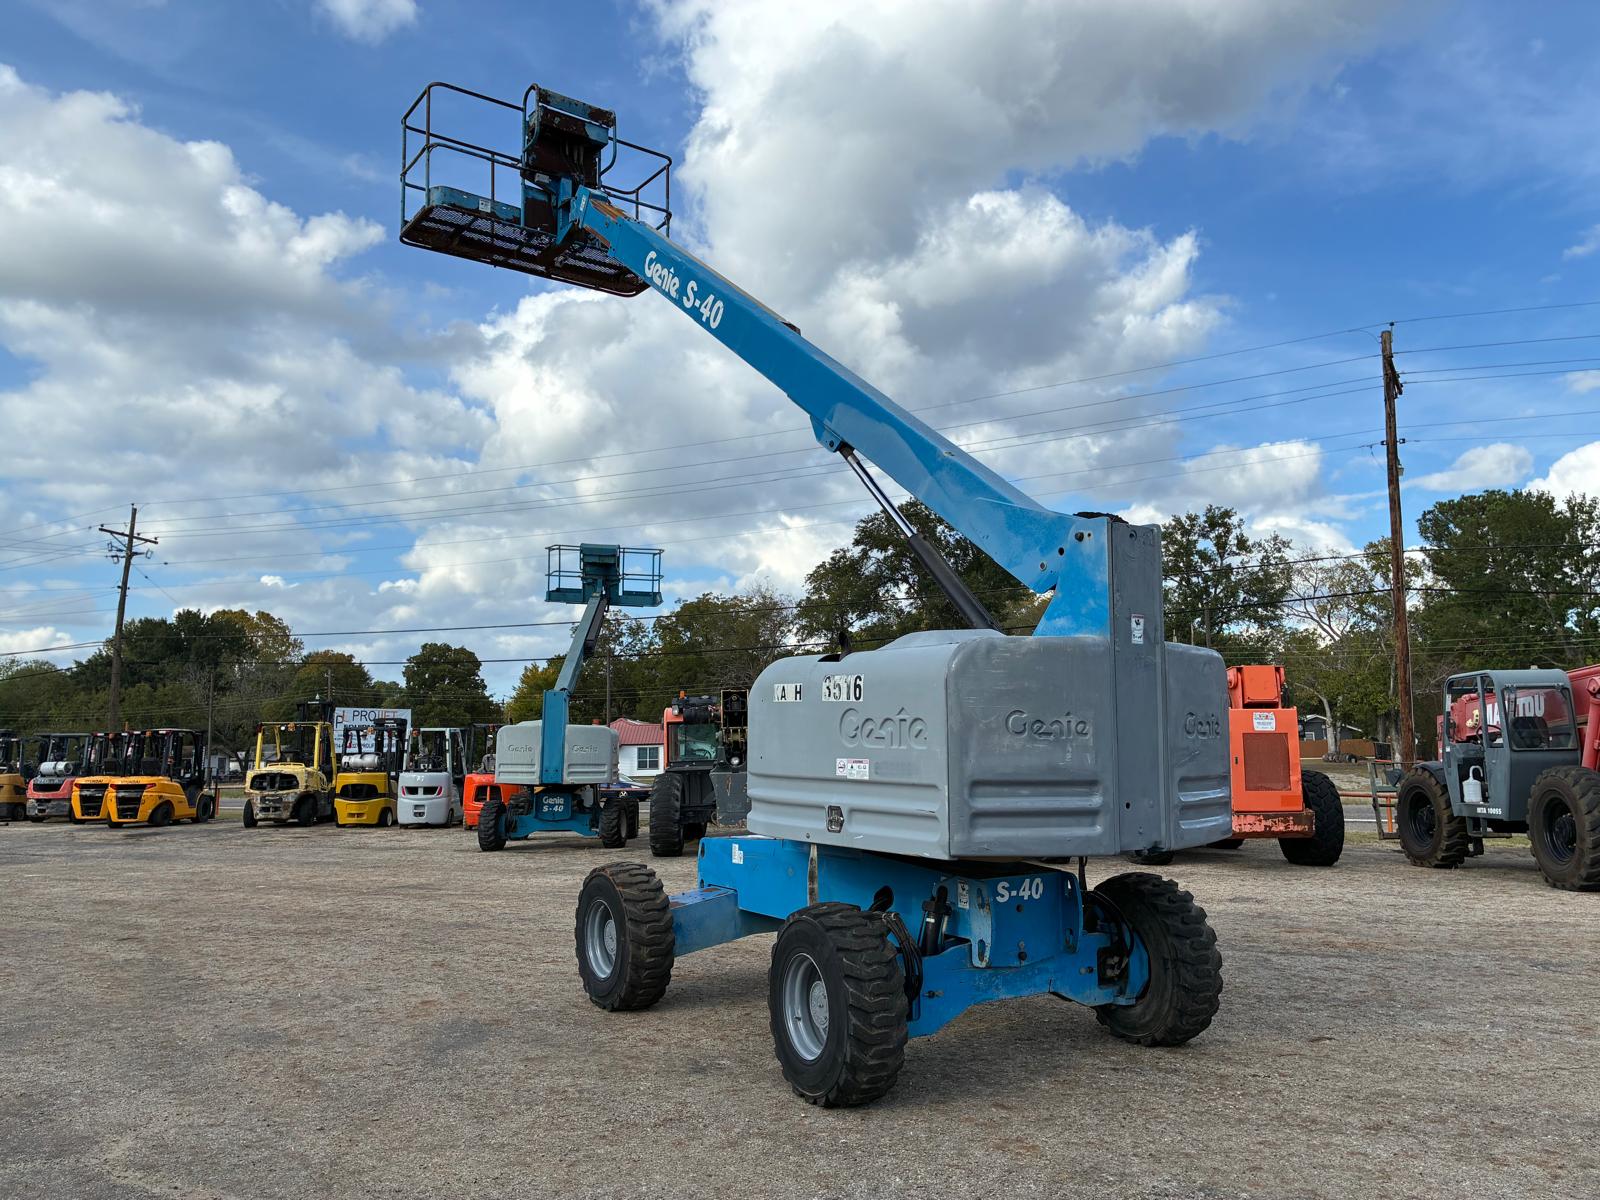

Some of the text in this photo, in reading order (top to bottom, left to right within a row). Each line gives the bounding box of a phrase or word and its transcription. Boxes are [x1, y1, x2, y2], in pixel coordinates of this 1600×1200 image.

[644, 250, 724, 330] Genie S-40
[839, 706, 929, 750] Genie
[1004, 709, 1091, 740] Genie
[1184, 711, 1221, 738] Genie
[508, 744, 533, 753] Genie
[542, 796, 565, 805] Genie
[995, 878, 1043, 903] S-40
